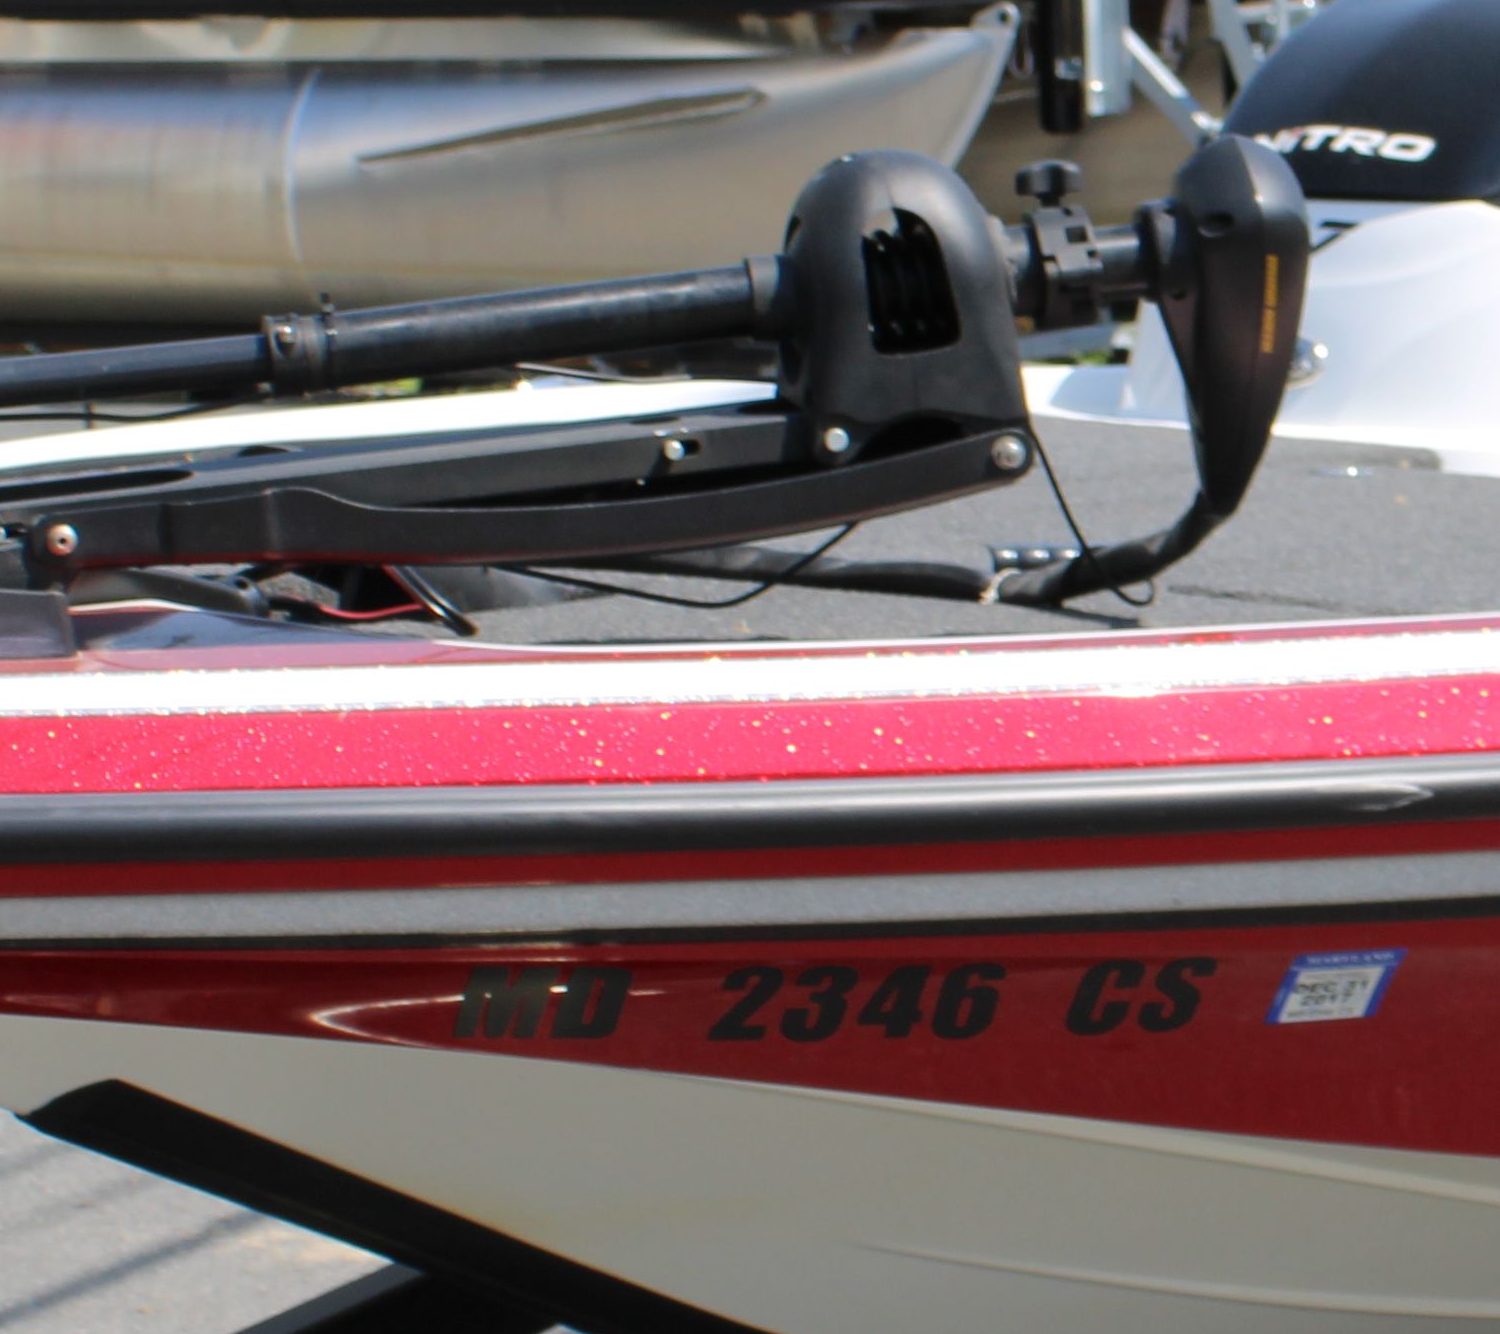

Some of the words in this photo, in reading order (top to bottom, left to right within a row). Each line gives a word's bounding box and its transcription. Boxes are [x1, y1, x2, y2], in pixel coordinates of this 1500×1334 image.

[453, 966, 633, 1039] MD
[707, 961, 1007, 1042] 2346
[1064, 958, 1217, 1036] CS
